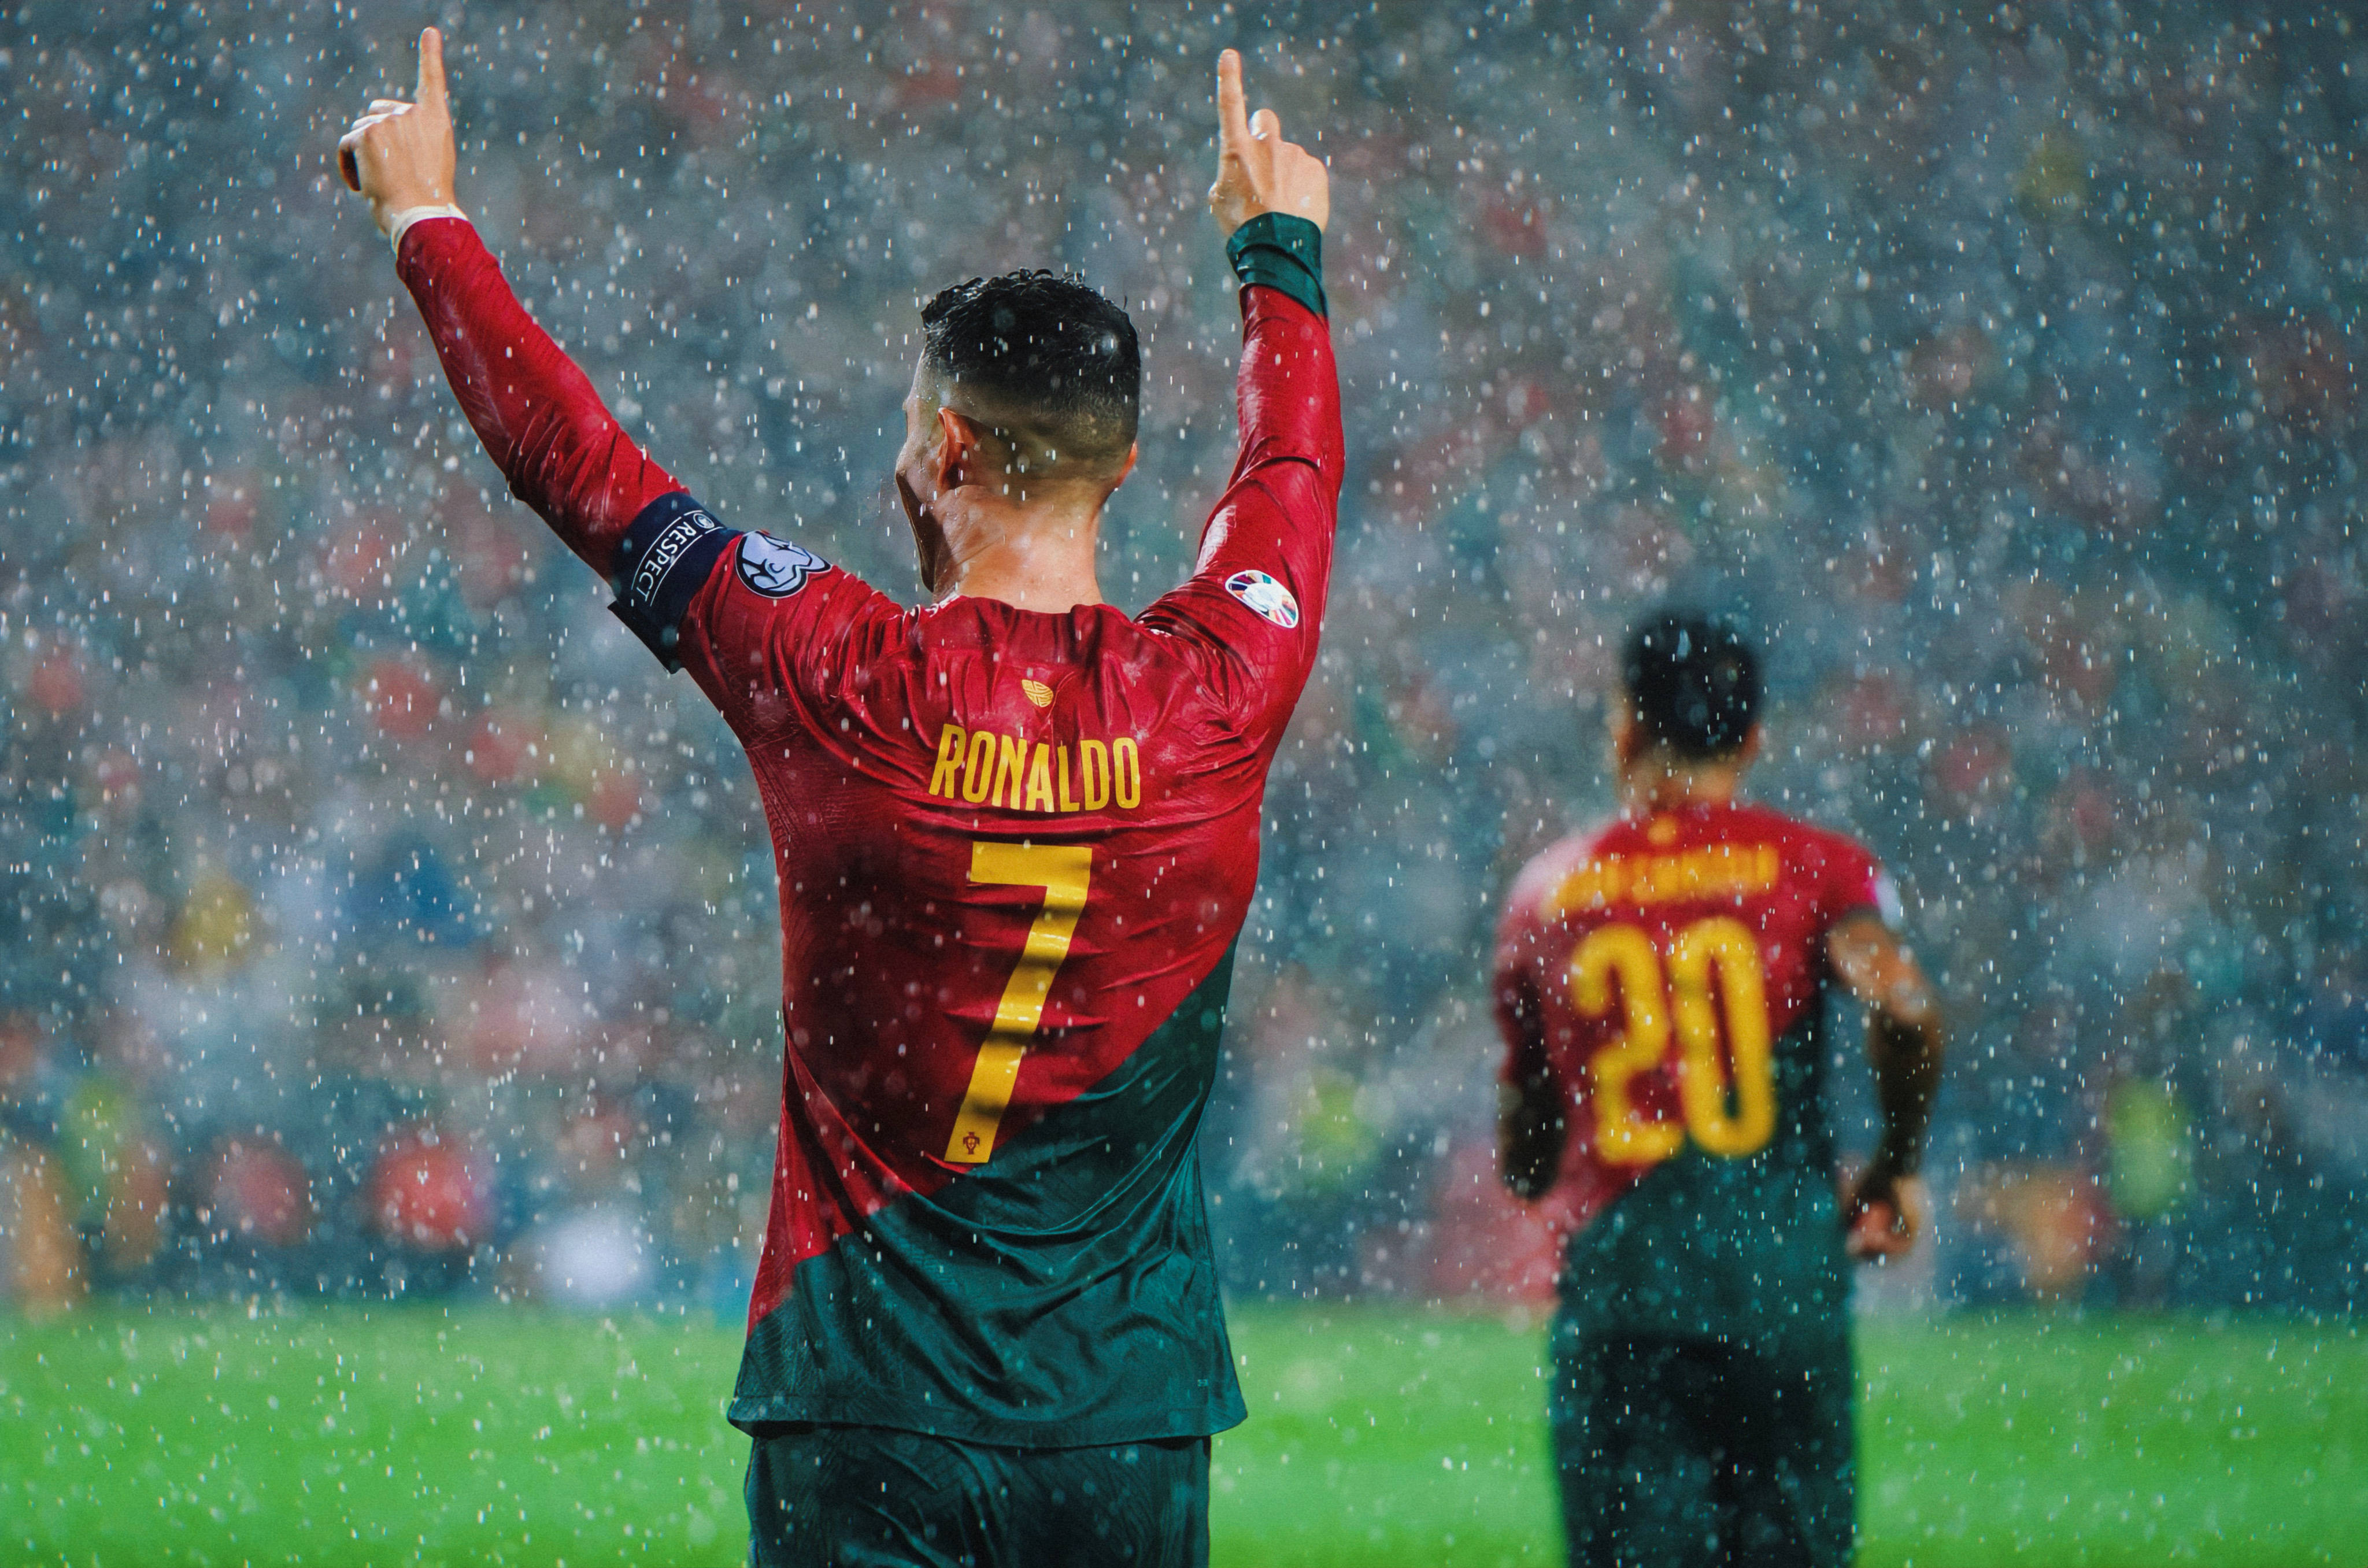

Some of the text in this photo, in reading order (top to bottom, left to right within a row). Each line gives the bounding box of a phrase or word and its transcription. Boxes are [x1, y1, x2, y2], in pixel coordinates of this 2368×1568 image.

[637, 522, 697, 601] RESPECT
[928, 723, 1140, 812] RONALDO
[944, 841, 1092, 1163] 7
[1570, 918, 1773, 1163] 20
